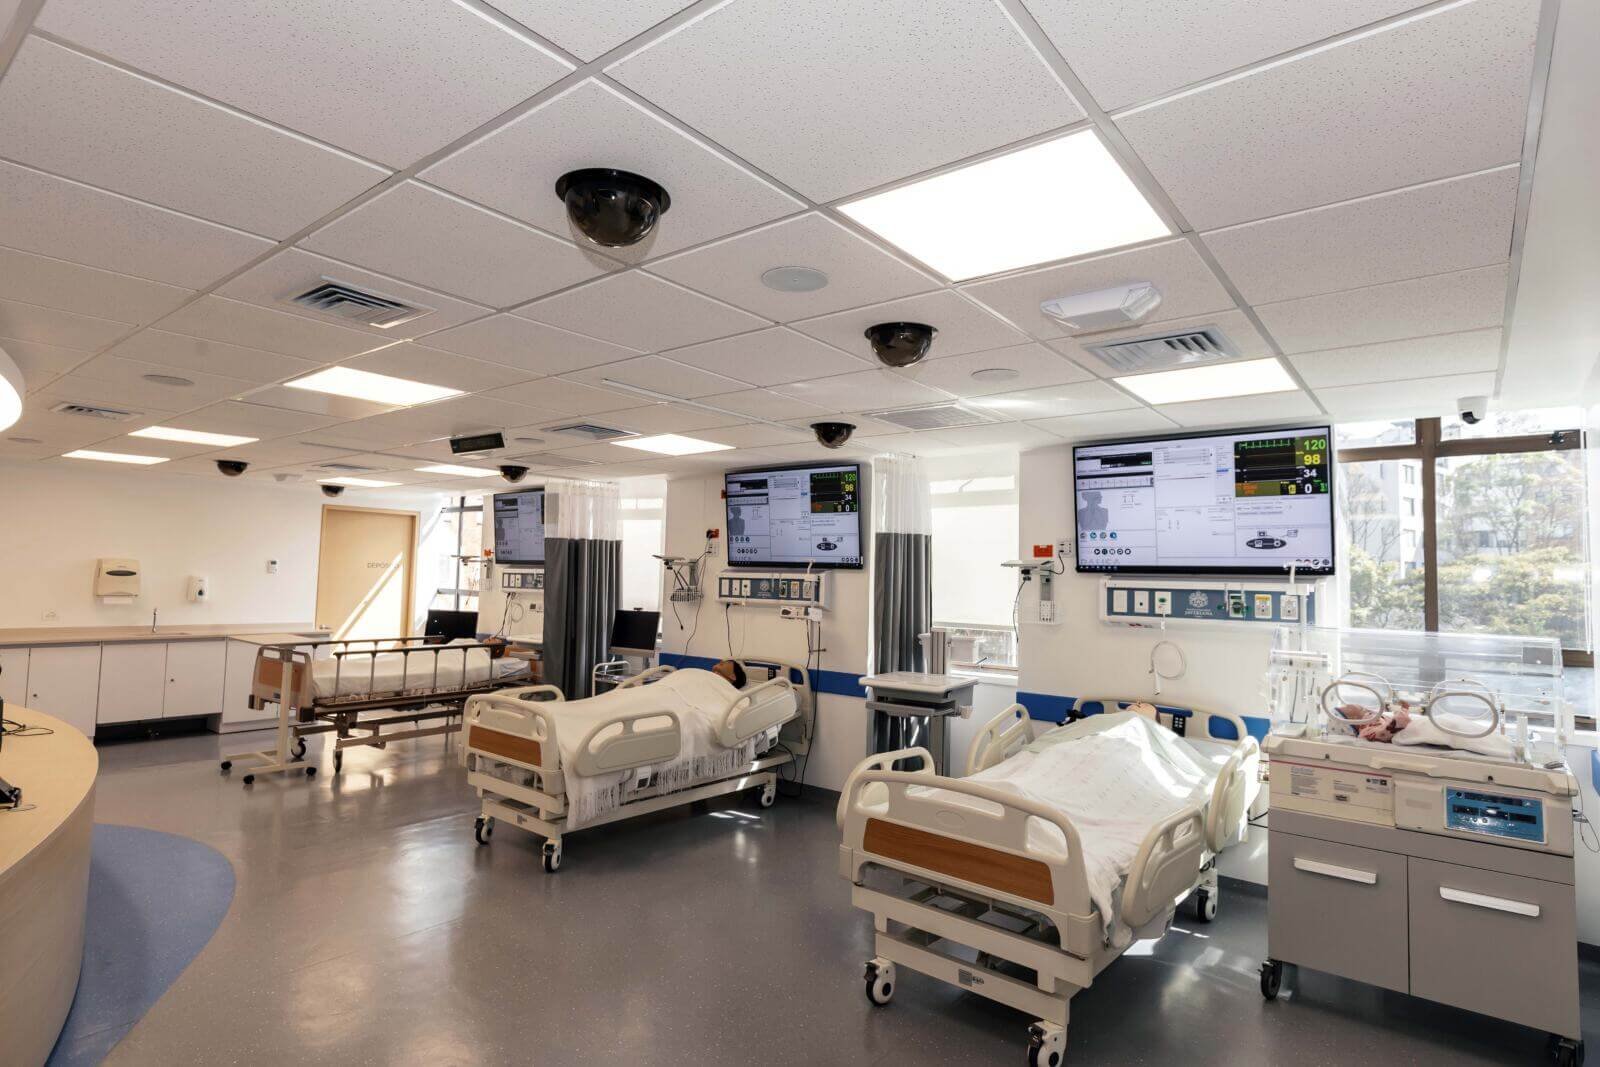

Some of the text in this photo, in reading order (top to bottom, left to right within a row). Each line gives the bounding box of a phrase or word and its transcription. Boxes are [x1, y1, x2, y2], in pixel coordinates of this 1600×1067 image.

[1304, 439, 1326, 450] 120
[1304, 454, 1321, 465] 98
[1304, 469, 1317, 478] 34
[1304, 483, 1313, 493] 0
